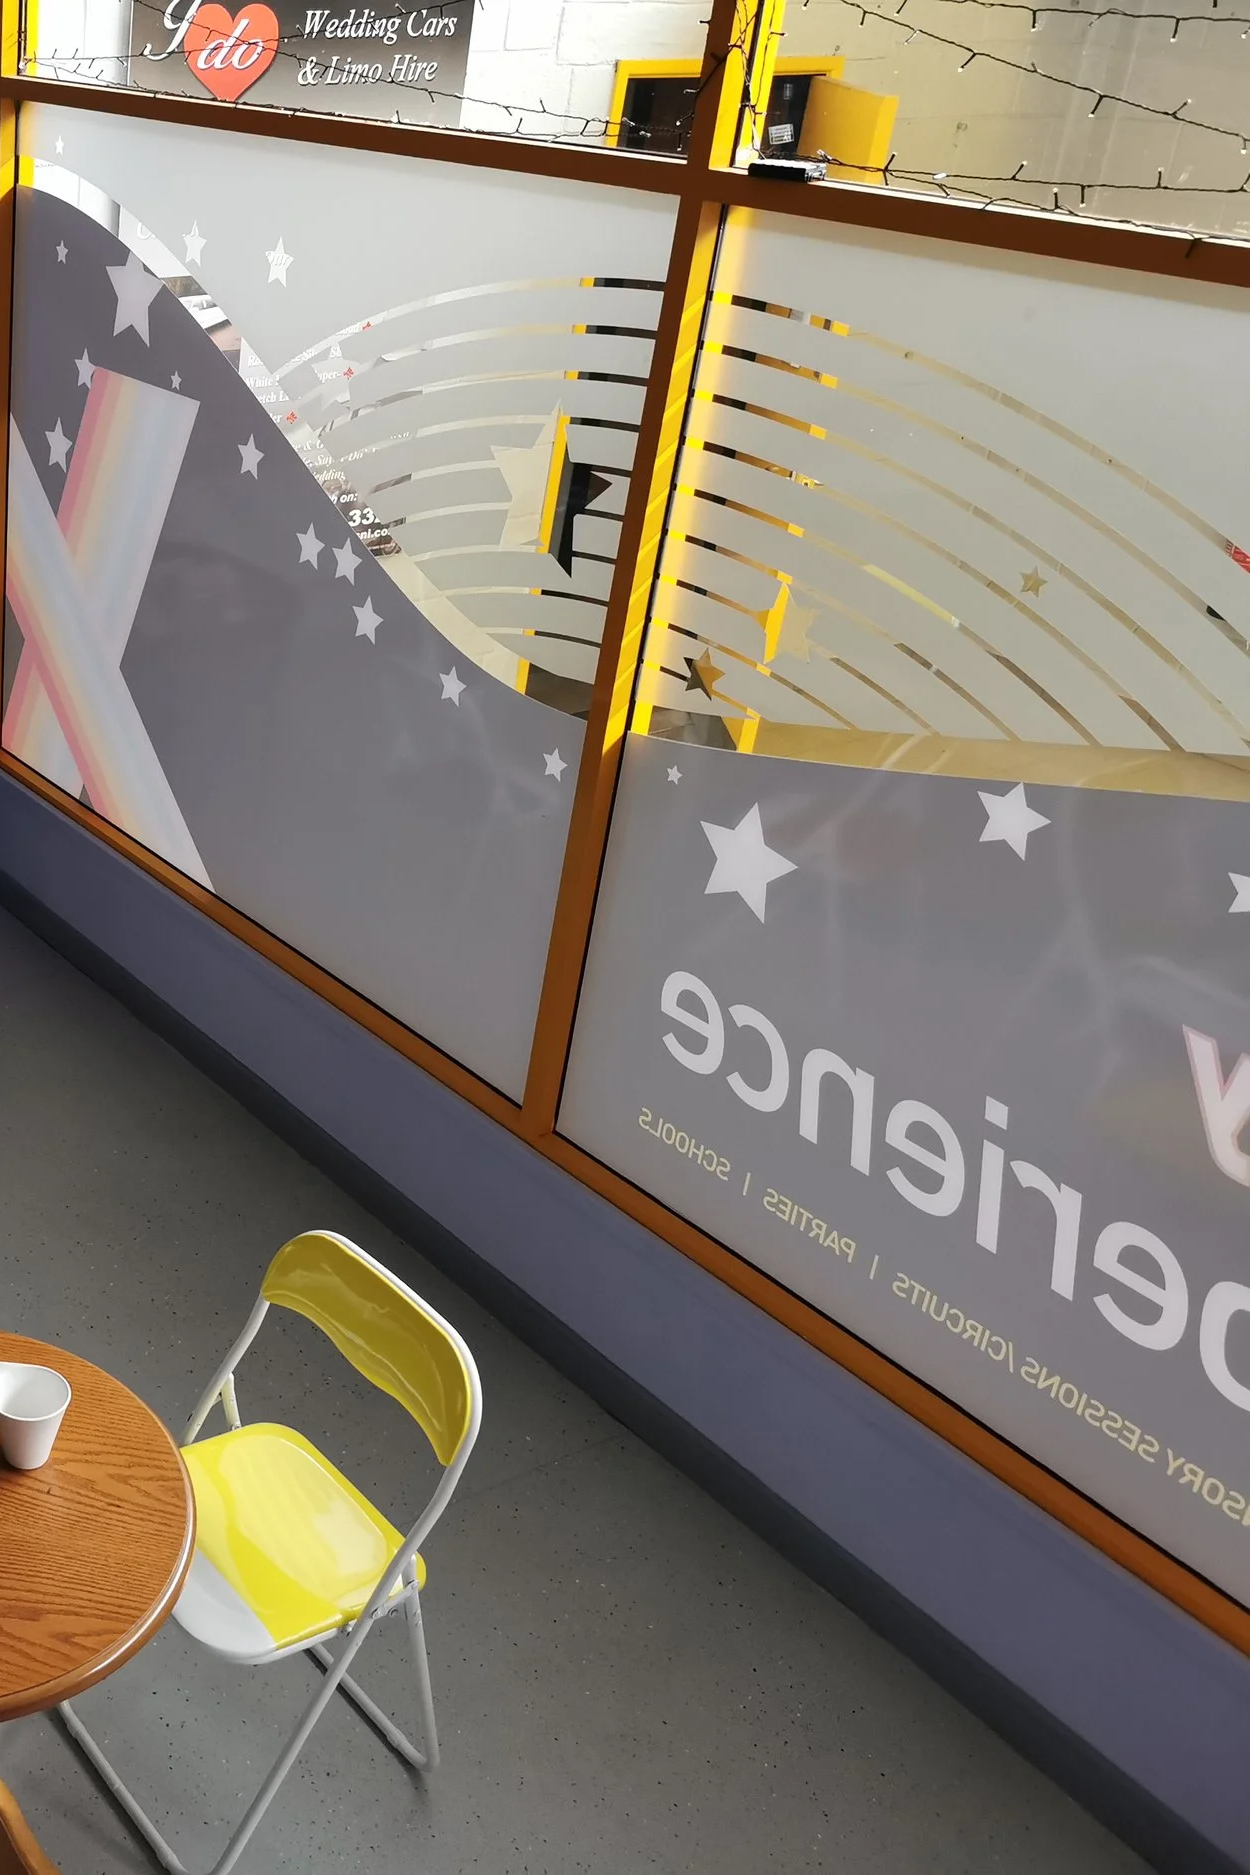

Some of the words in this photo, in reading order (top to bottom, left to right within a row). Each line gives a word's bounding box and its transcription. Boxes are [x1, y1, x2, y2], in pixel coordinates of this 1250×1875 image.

[196, 18, 263, 70] do
[303, 9, 402, 45] Wedding
[406, 9, 458, 37] Cars
[297, 56, 318, 86] &
[325, 54, 383, 85] Limo
[387, 54, 439, 84] Hire
[340, 493, 359, 504] on:
